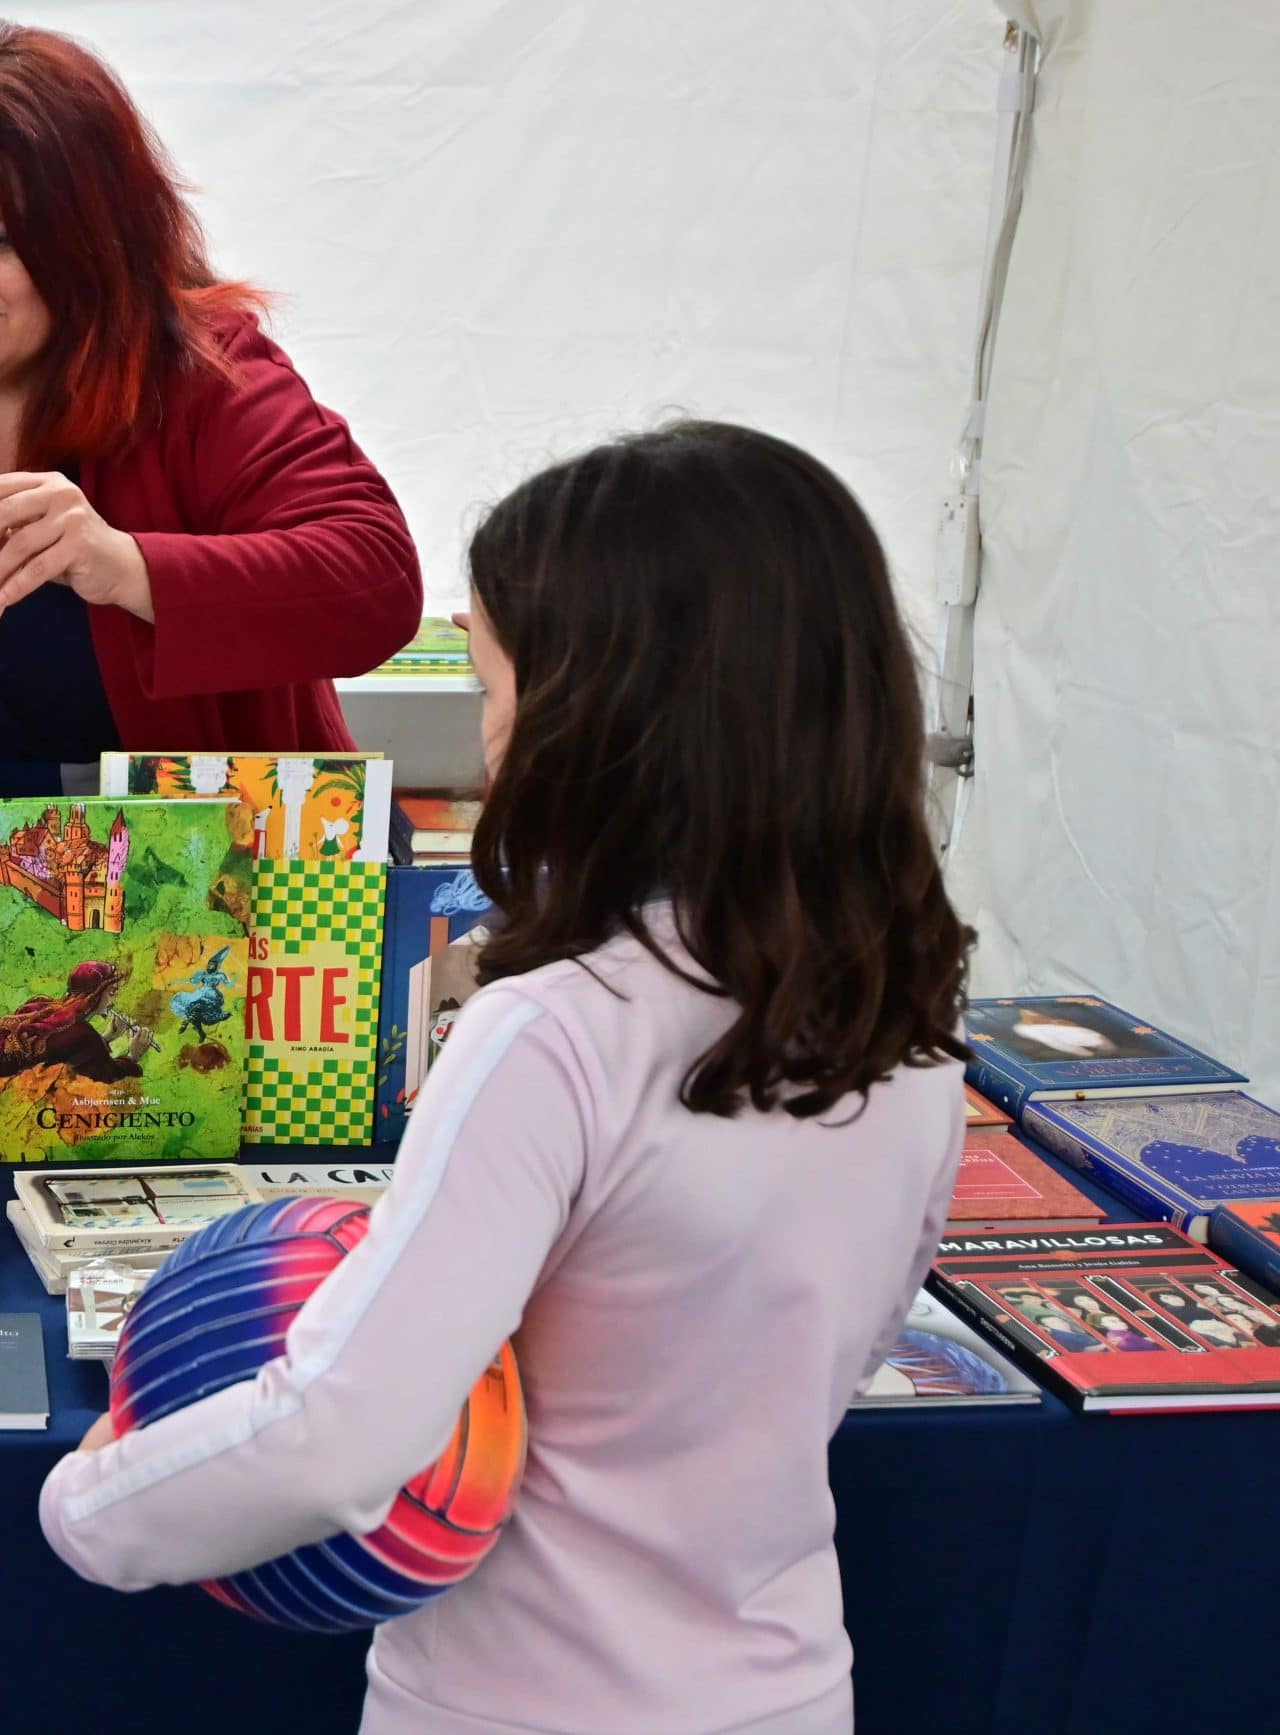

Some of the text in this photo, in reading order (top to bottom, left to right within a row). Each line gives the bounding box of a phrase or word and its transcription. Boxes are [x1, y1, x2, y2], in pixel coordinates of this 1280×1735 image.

[127, 1096, 137, 1105] &
[113, 1133, 125, 1142] por
[261, 1171, 312, 1184] LA
[937, 1234, 1164, 1252] MARAVILLOSAS
